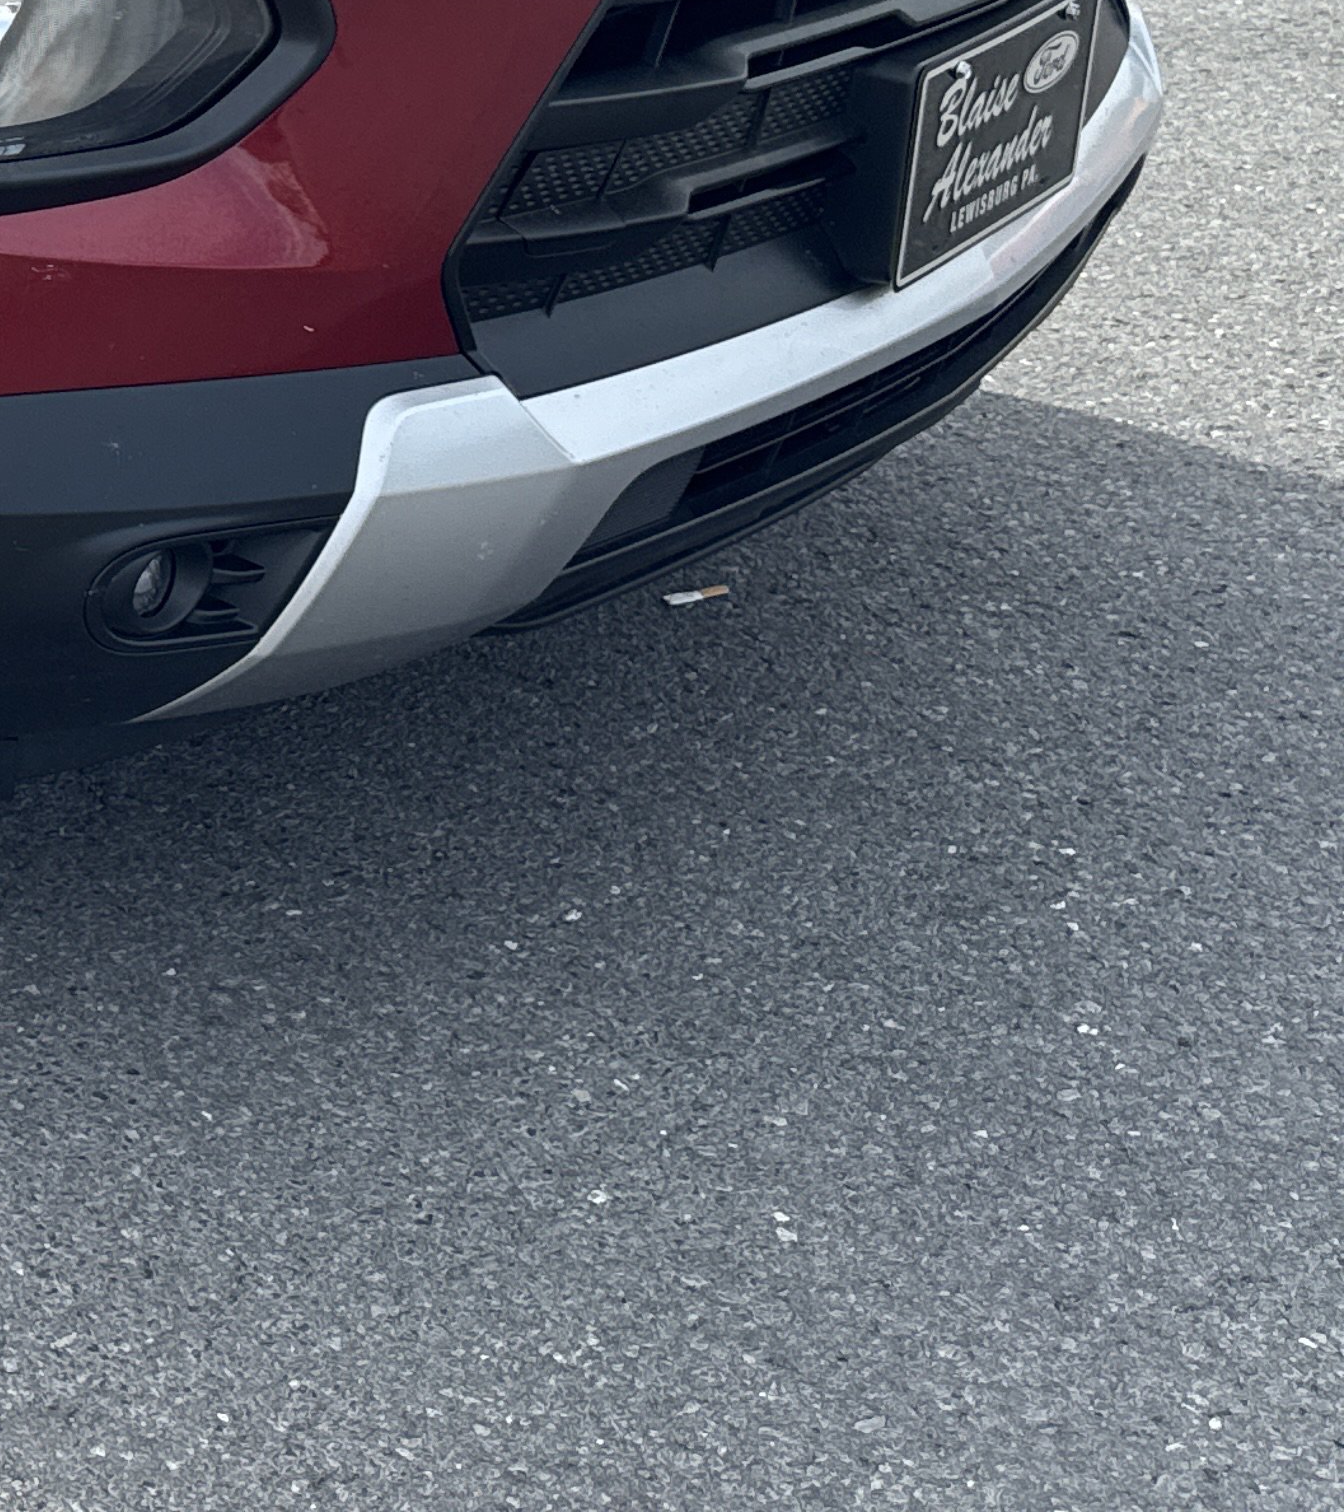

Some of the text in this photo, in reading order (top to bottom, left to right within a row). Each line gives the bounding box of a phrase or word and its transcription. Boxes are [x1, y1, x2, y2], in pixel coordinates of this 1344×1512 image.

[936, 73, 1021, 148] Blaise
[922, 104, 1054, 224] Alexander
[949, 175, 1019, 234] LEWISBURG
